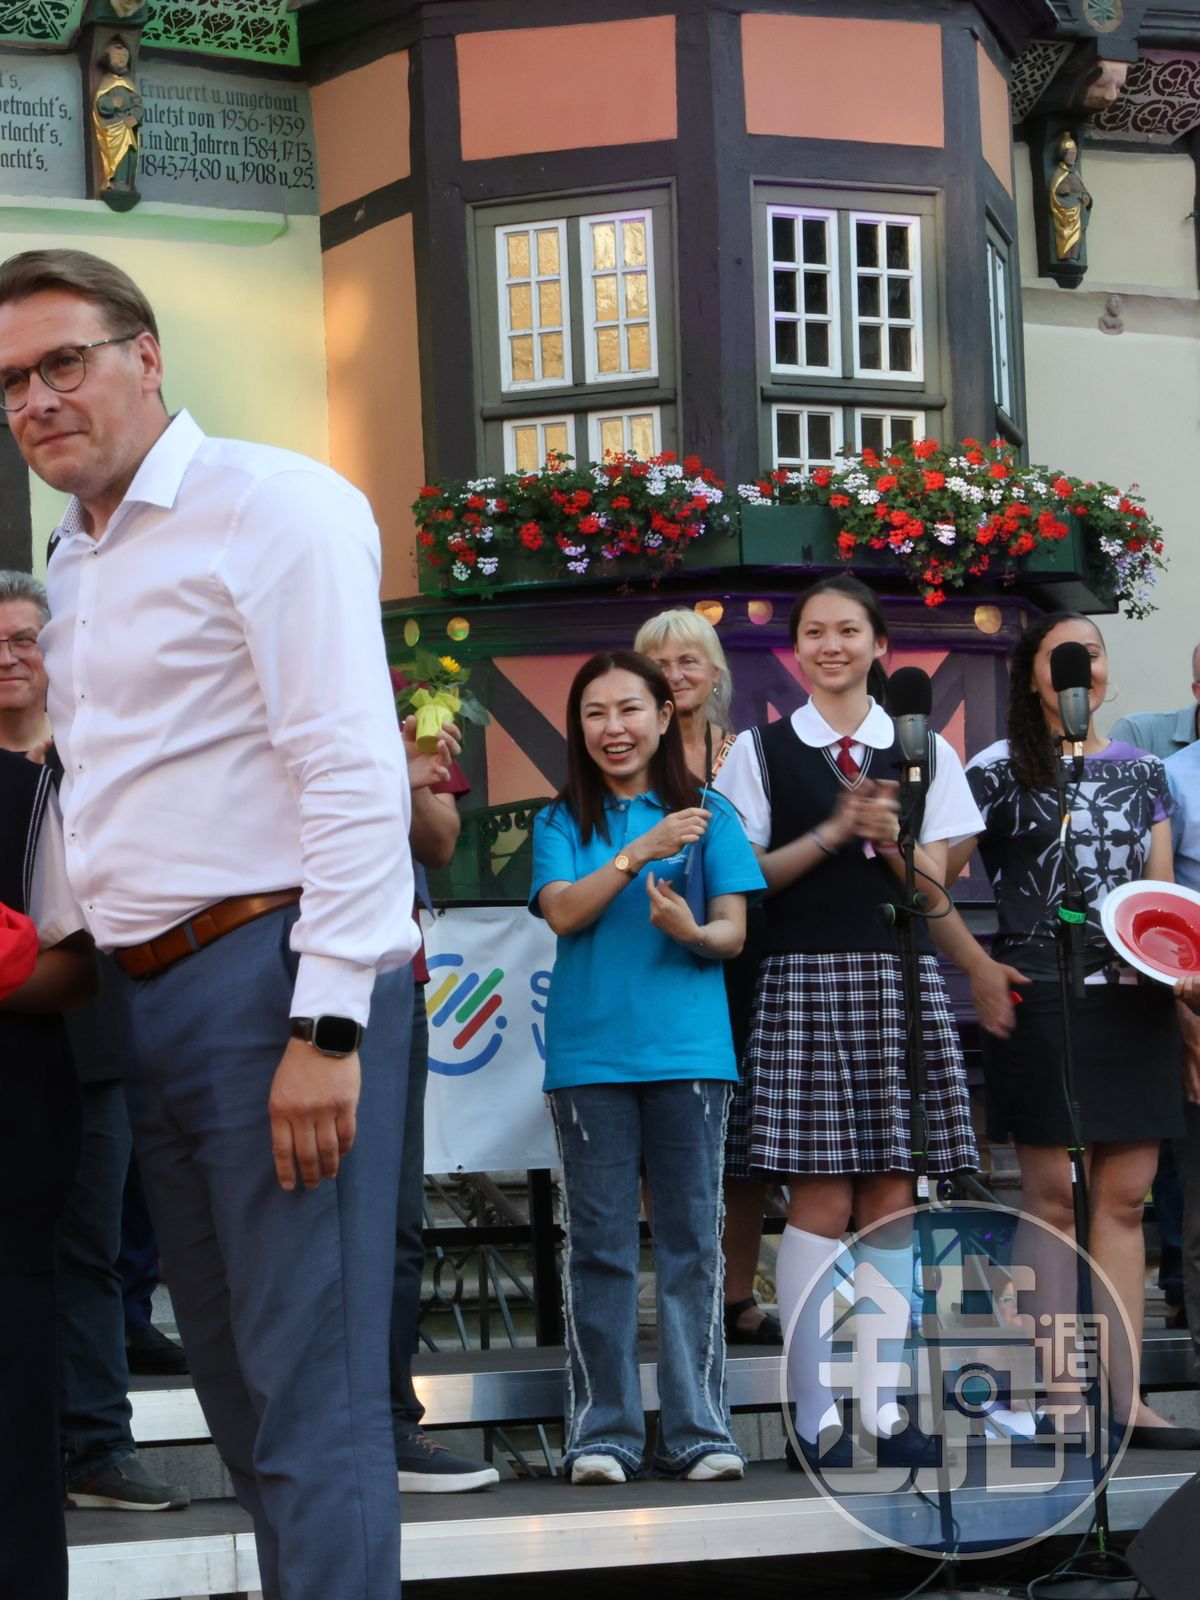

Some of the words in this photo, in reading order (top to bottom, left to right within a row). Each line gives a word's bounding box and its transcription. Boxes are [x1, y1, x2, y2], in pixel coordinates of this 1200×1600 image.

[139, 79, 207, 103] Erneuert
[226, 92, 299, 113] umgebaut
[188, 111, 216, 129] von
[165, 130, 189, 153] den
[190, 131, 240, 157] Jahren
